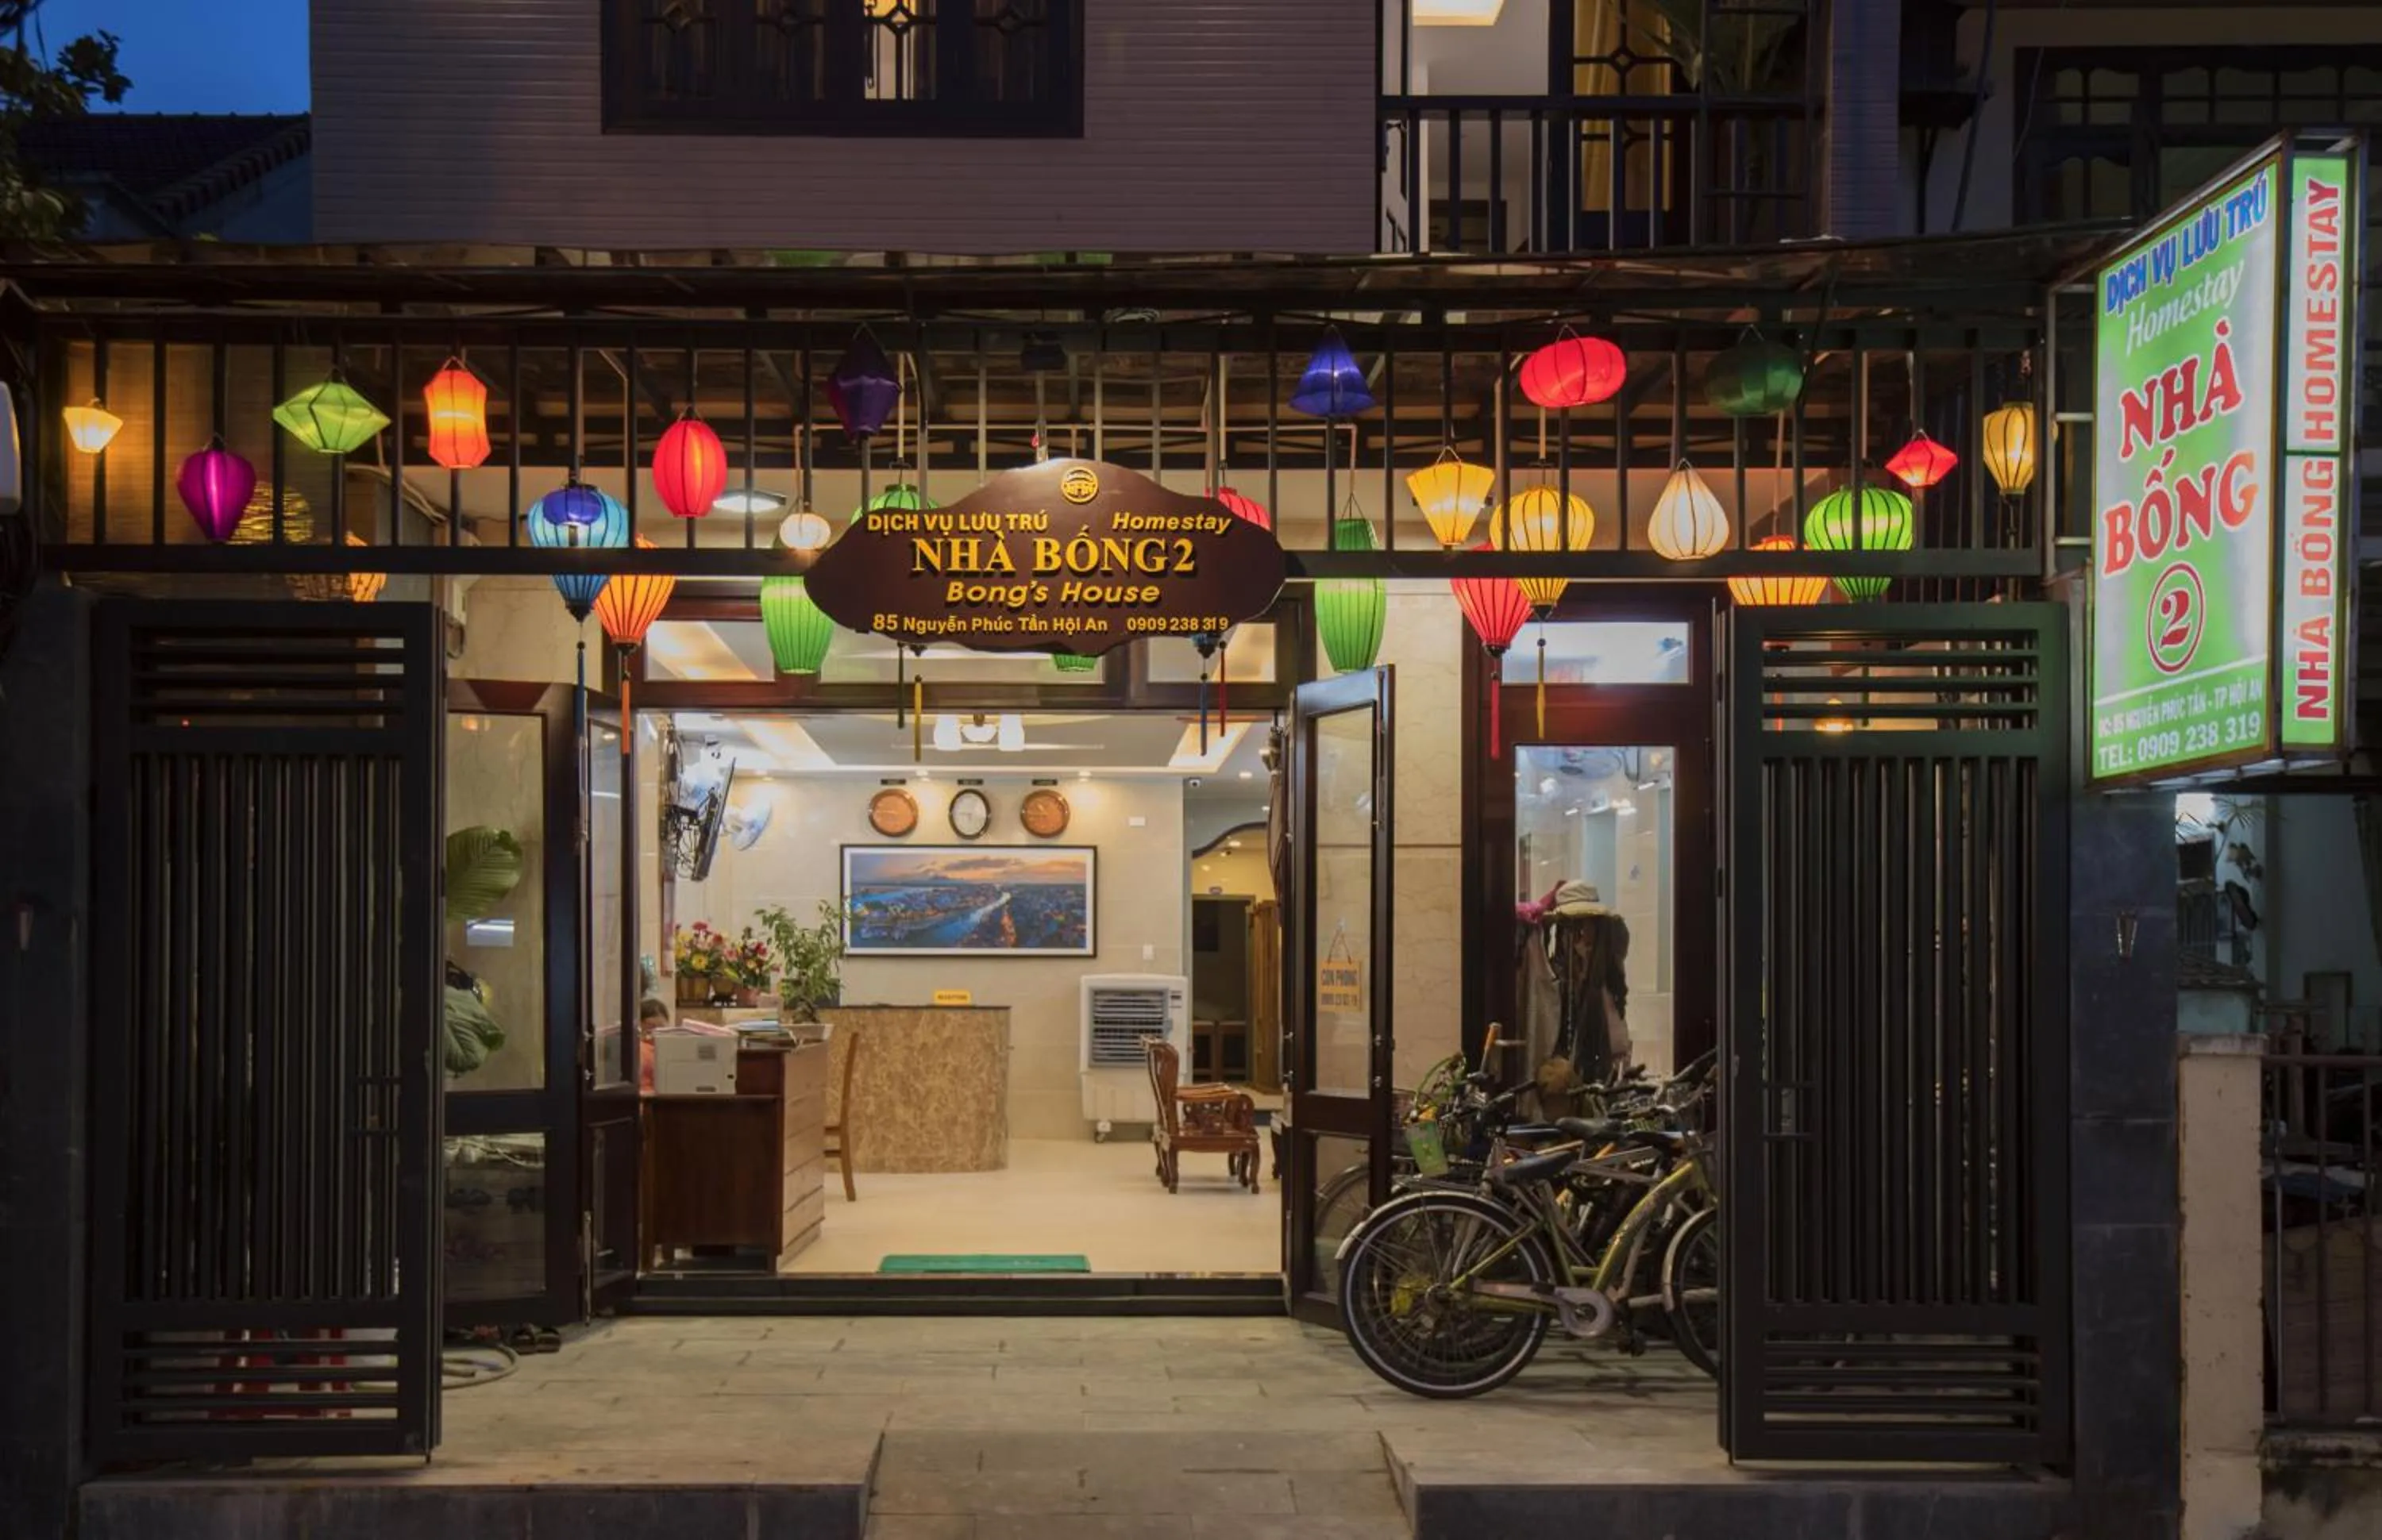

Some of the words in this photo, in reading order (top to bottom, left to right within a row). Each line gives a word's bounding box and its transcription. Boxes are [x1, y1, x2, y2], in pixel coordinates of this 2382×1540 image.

[2106, 252, 2149, 316] DỊCH
[2151, 234, 2178, 287] VỤ
[2180, 206, 2222, 269] LƯU
[2225, 169, 2268, 241] TRÚ
[2126, 259, 2245, 356] Homestay
[2304, 179, 2339, 441] HOMESTAY
[868, 514, 919, 535] DỊCH
[924, 514, 953, 536] VỤ
[958, 512, 1001, 531] LƯU
[1005, 510, 1048, 531] TRÚ
[1112, 512, 1231, 534] Homestay
[2103, 448, 2259, 576] BỐNG
[912, 530, 1016, 572] NHÀ
[946, 581, 1048, 607] Bong's
[1061, 581, 1160, 603] House
[2160, 588, 2191, 649] 2
[873, 614, 898, 631] 85
[903, 616, 967, 635] Nguyễn
[971, 616, 1013, 631] Phúc
[1053, 617, 1081, 636] Hội
[1085, 617, 1108, 631] An
[1127, 617, 1166, 631] 0909
[1170, 617, 1199, 631] 238
[1202, 617, 1228, 631] 319
[2099, 743, 2133, 770] TEL:
[2137, 730, 2180, 763] 0909
[2185, 721, 2219, 752] 238
[2225, 711, 2261, 743] 319
